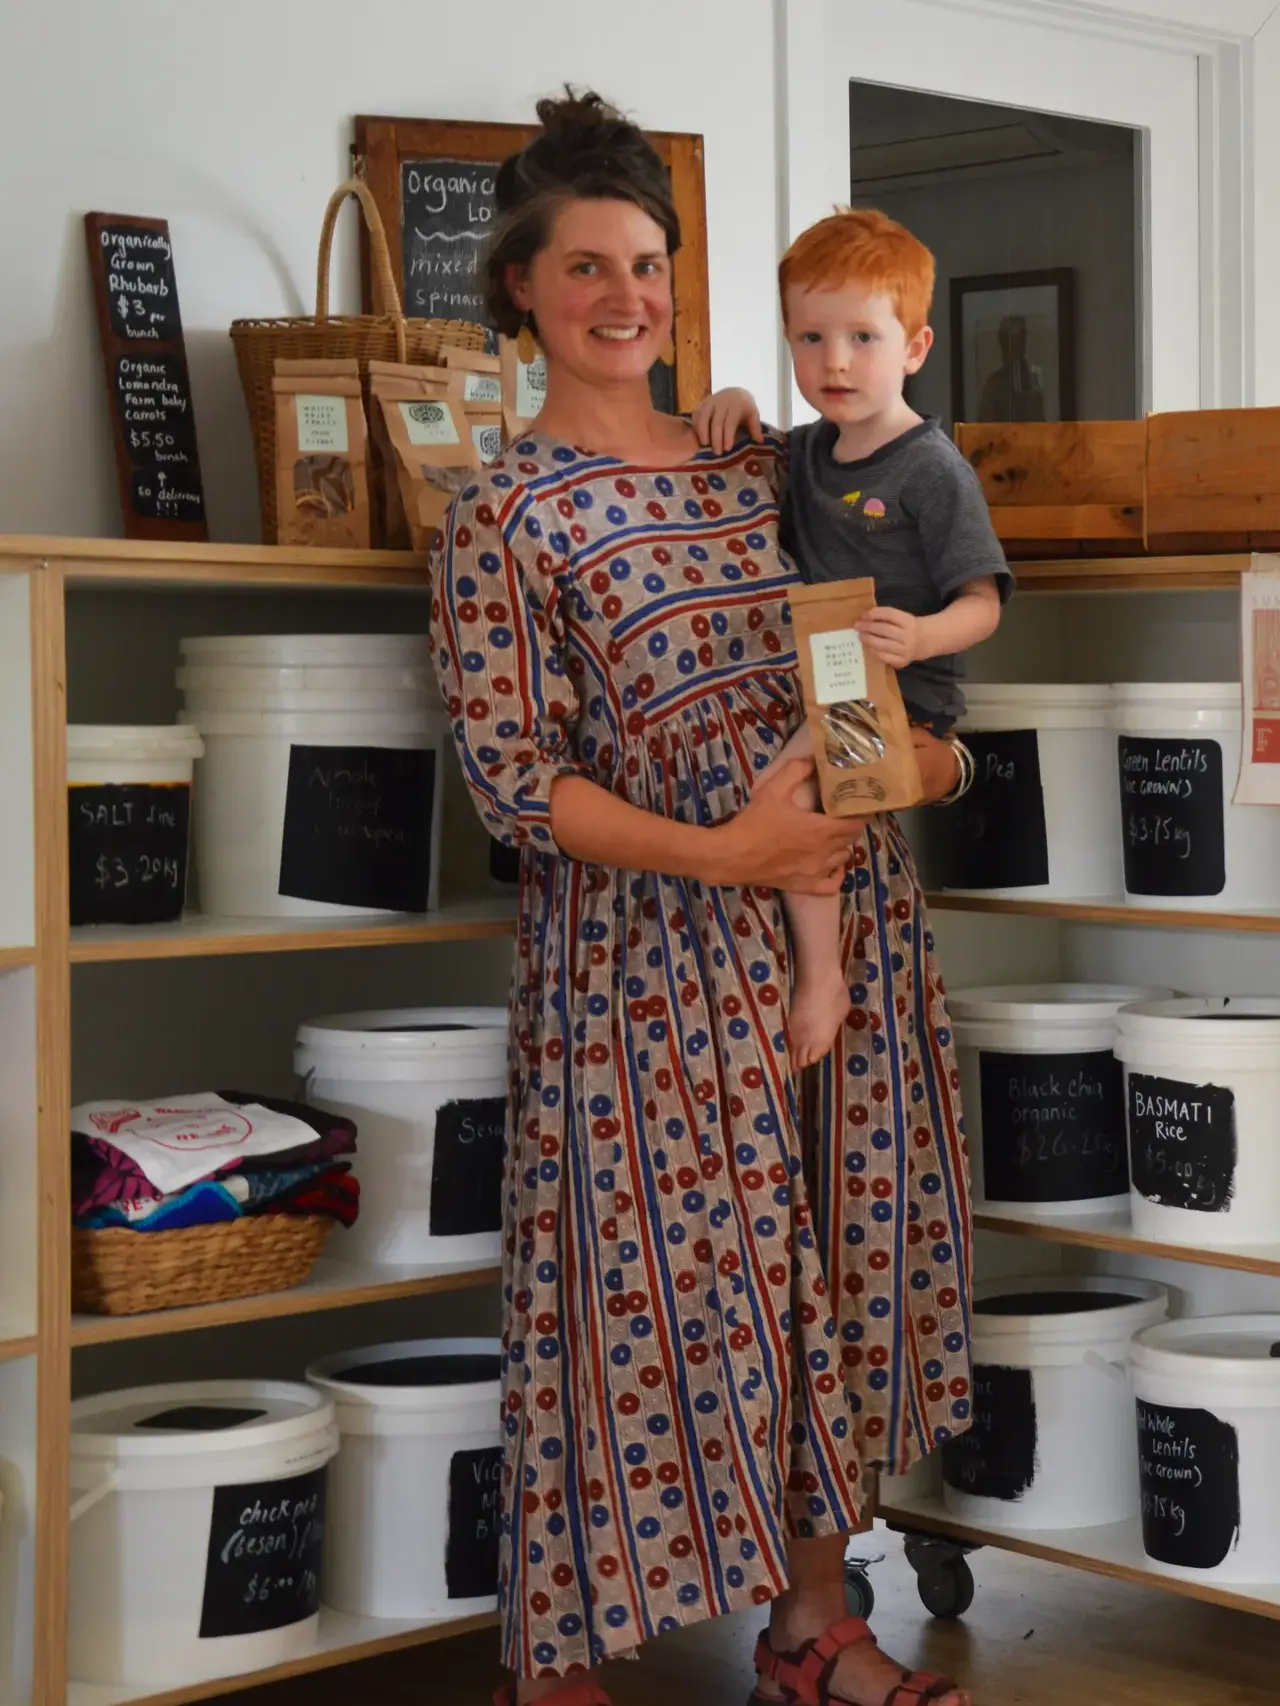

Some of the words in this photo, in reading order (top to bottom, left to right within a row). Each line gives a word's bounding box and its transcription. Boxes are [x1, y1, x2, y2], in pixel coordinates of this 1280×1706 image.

[101, 231, 171, 260] Organically
[109, 273, 168, 296] Rhubarb
[126, 323, 159, 339] bunch
[120, 359, 166, 378] Organic
[130, 428, 174, 448] $5.50
[154, 449, 189, 463] bunch
[1154, 748, 1208, 773] Lentils
[80, 802, 134, 827] SALT
[1135, 1091, 1213, 1125] BASMATI
[1154, 1120, 1188, 1141] Rice
[1152, 1437, 1198, 1460] Lentils
